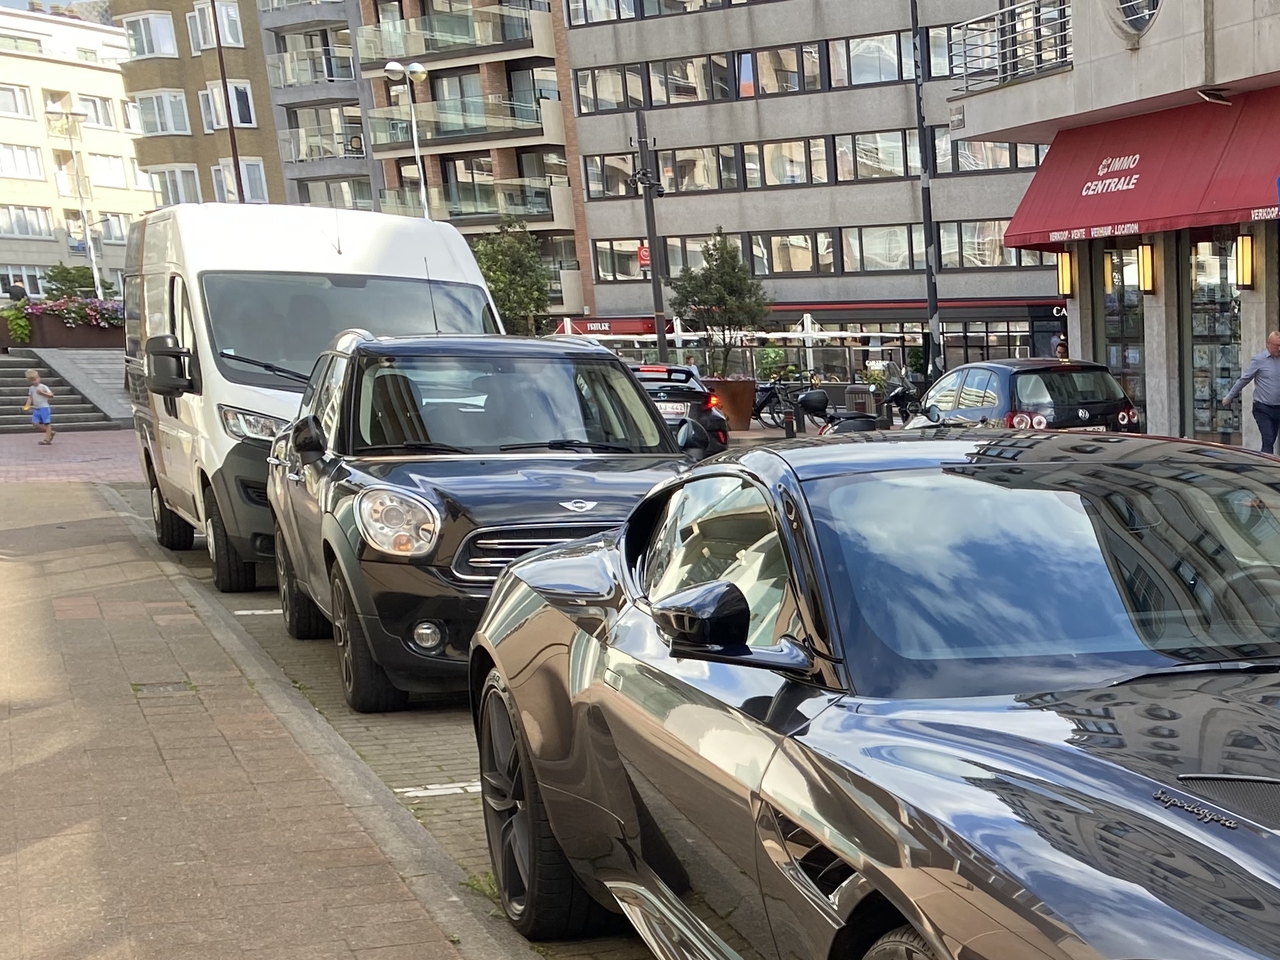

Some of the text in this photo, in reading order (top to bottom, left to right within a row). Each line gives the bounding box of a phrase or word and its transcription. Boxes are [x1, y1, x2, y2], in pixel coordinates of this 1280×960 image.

[1108, 154, 1140, 173] IMMO
[1081, 174, 1140, 196] CENTRALE
[1251, 207, 1279, 221] VERKOOP
[1071, 228, 1086, 240] VENTE
[1114, 222, 1139, 235] LOCATION
[1052, 306, 1068, 317] CA
[658, 403, 683, 412] AJ-442
[1152, 787, 1238, 829] Superleggera
